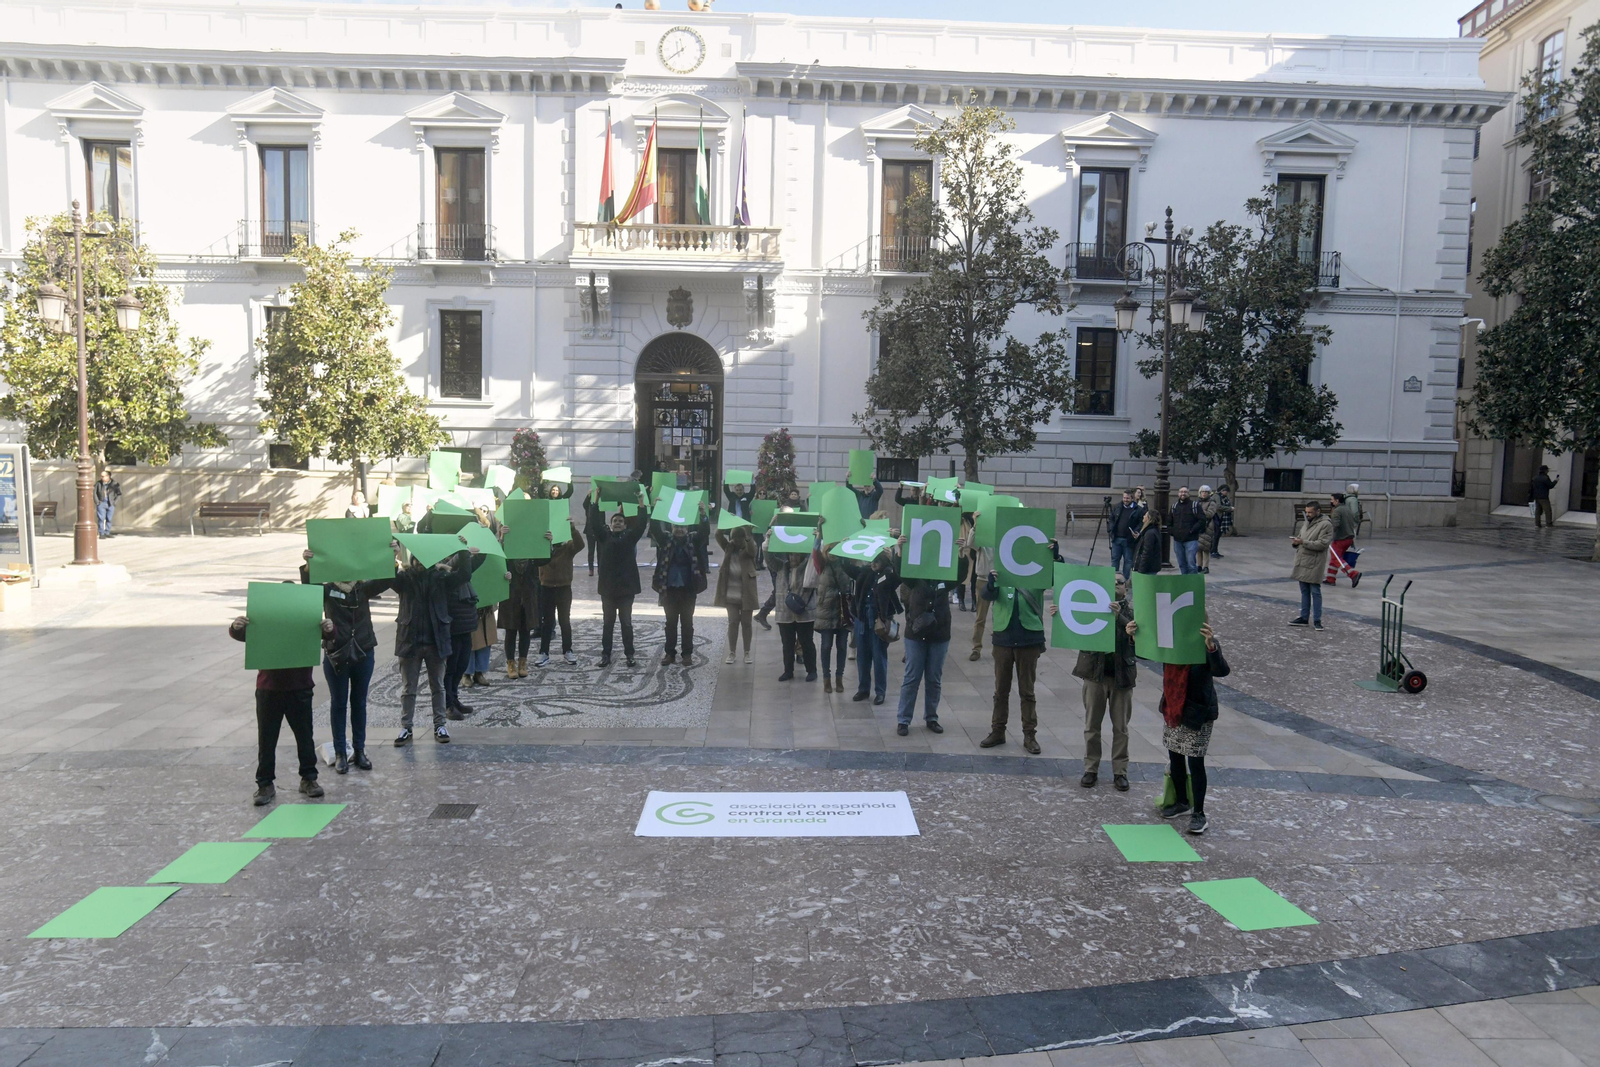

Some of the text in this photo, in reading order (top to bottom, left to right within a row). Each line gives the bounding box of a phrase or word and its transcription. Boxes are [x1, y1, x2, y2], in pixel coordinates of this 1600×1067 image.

[907, 518, 954, 568] n
[999, 525, 1049, 576] c
[1058, 579, 1112, 636] e
[1155, 591, 1194, 649] r
[821, 802, 896, 810] española
